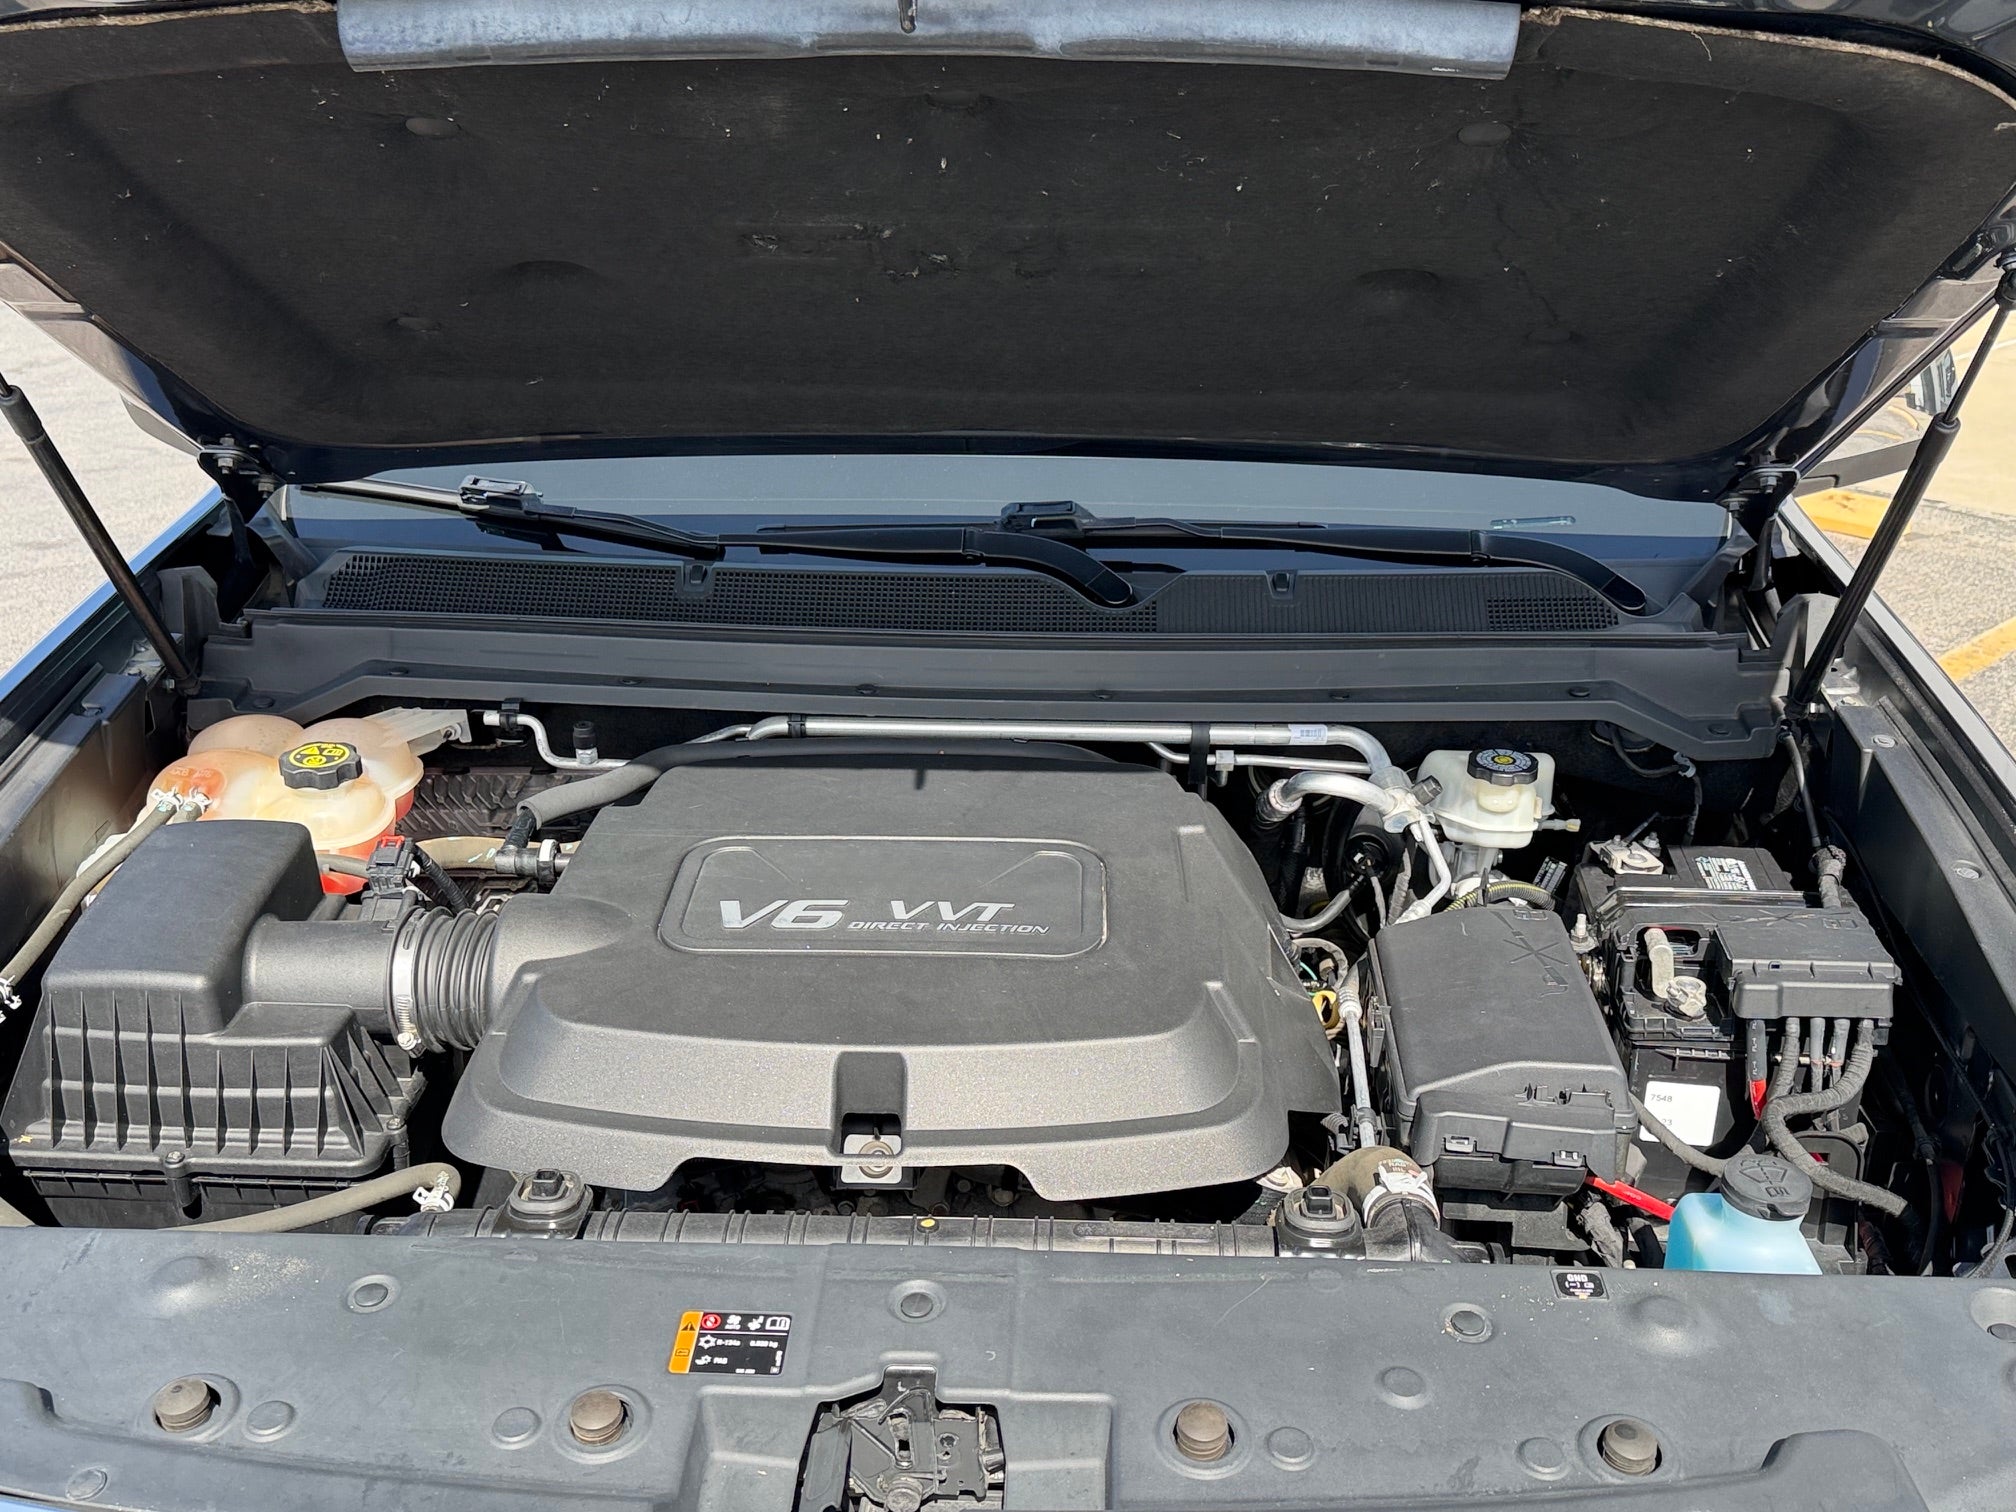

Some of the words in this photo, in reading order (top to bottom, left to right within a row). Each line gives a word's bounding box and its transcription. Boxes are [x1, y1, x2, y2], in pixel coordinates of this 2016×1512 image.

[720, 899, 849, 930] V6
[890, 900, 1016, 922] VVT
[847, 921, 930, 931] DIRECT
[936, 922, 1050, 936] INJECTION
[1650, 1093, 1673, 1103] 7548
